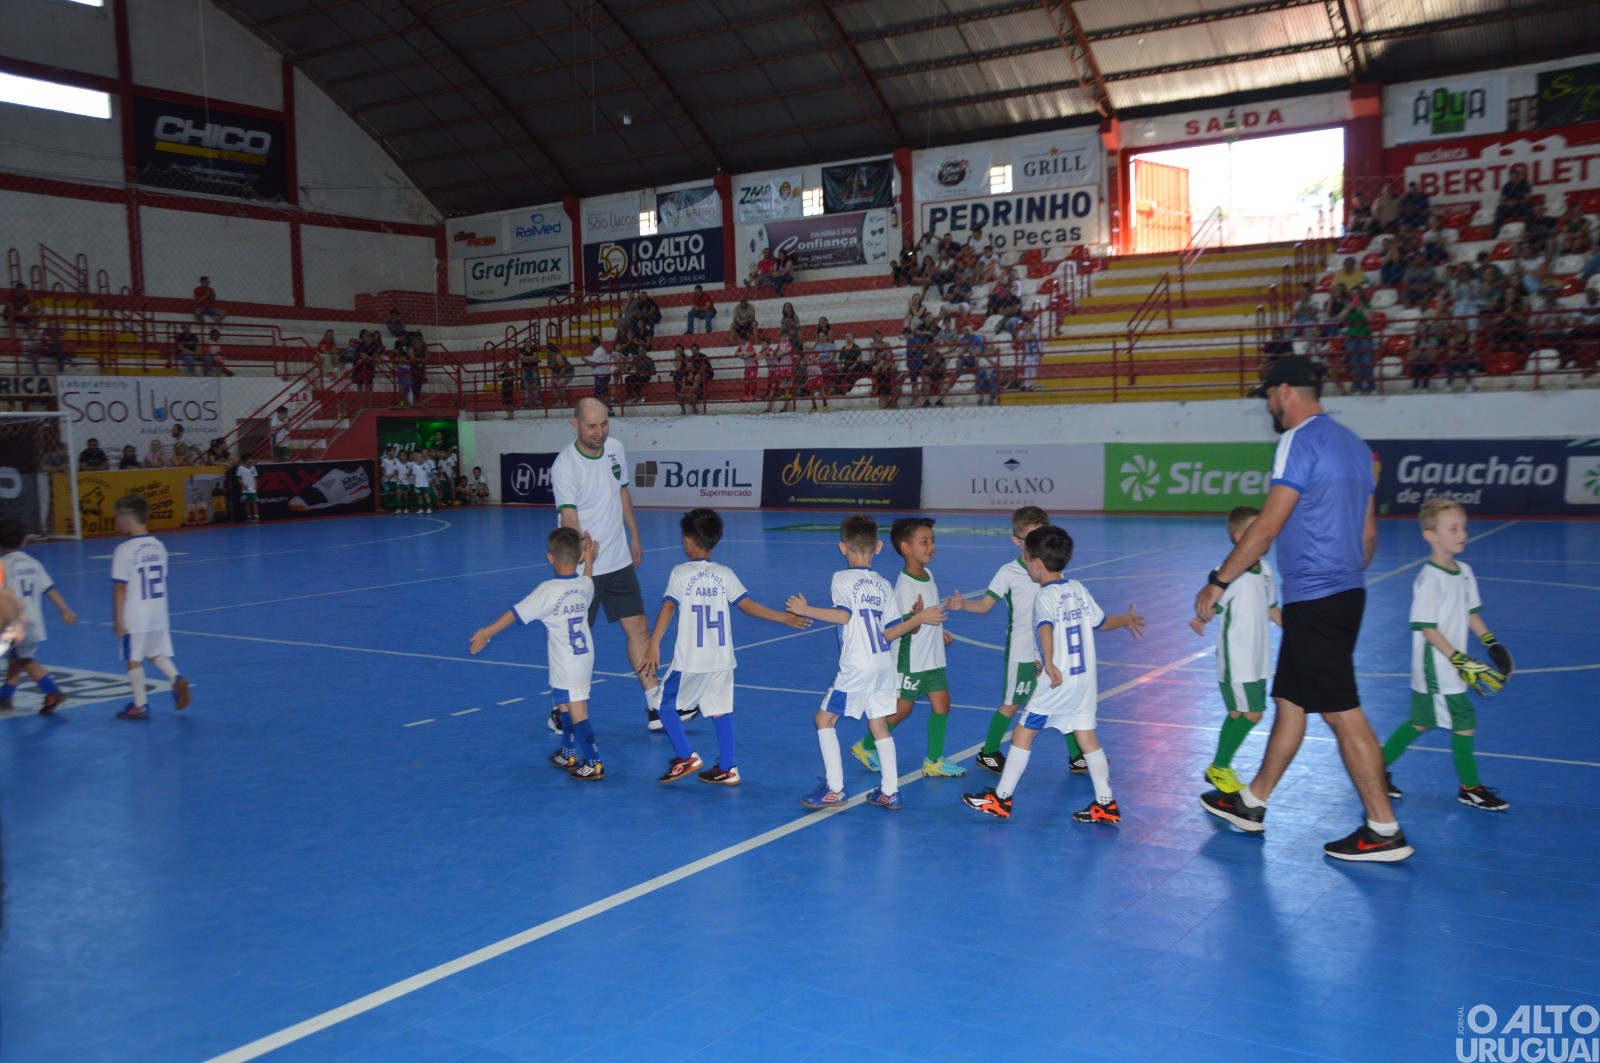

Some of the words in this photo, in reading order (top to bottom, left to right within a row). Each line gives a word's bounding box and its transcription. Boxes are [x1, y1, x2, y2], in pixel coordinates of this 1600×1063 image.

[154, 115, 272, 156] CHICO
[1023, 155, 1084, 178] GRILL
[928, 191, 1093, 234] PEDRINHO
[638, 240, 653, 260] O
[655, 234, 705, 259] ALTO
[1013, 227, 1082, 248] Peças
[472, 258, 562, 287] Grafimax
[631, 254, 705, 277] URUGUAI
[62, 391, 129, 423] São
[782, 452, 899, 485] Marathon
[1396, 454, 1560, 486] Gauchão
[538, 470, 553, 491] H
[971, 477, 1055, 495] LUGANO
[699, 488, 753, 500] Supermercado
[1396, 489, 1422, 504] de
[138, 565, 164, 601] 12
[695, 587, 719, 597] AABB
[710, 573, 727, 597] FUTAL
[563, 603, 586, 616] AABB
[861, 593, 882, 606] AABB
[568, 616, 589, 655] 6
[691, 604, 726, 648] 14
[1066, 624, 1086, 676] 9
[902, 675, 921, 691] 62
[1015, 680, 1032, 696] 44
